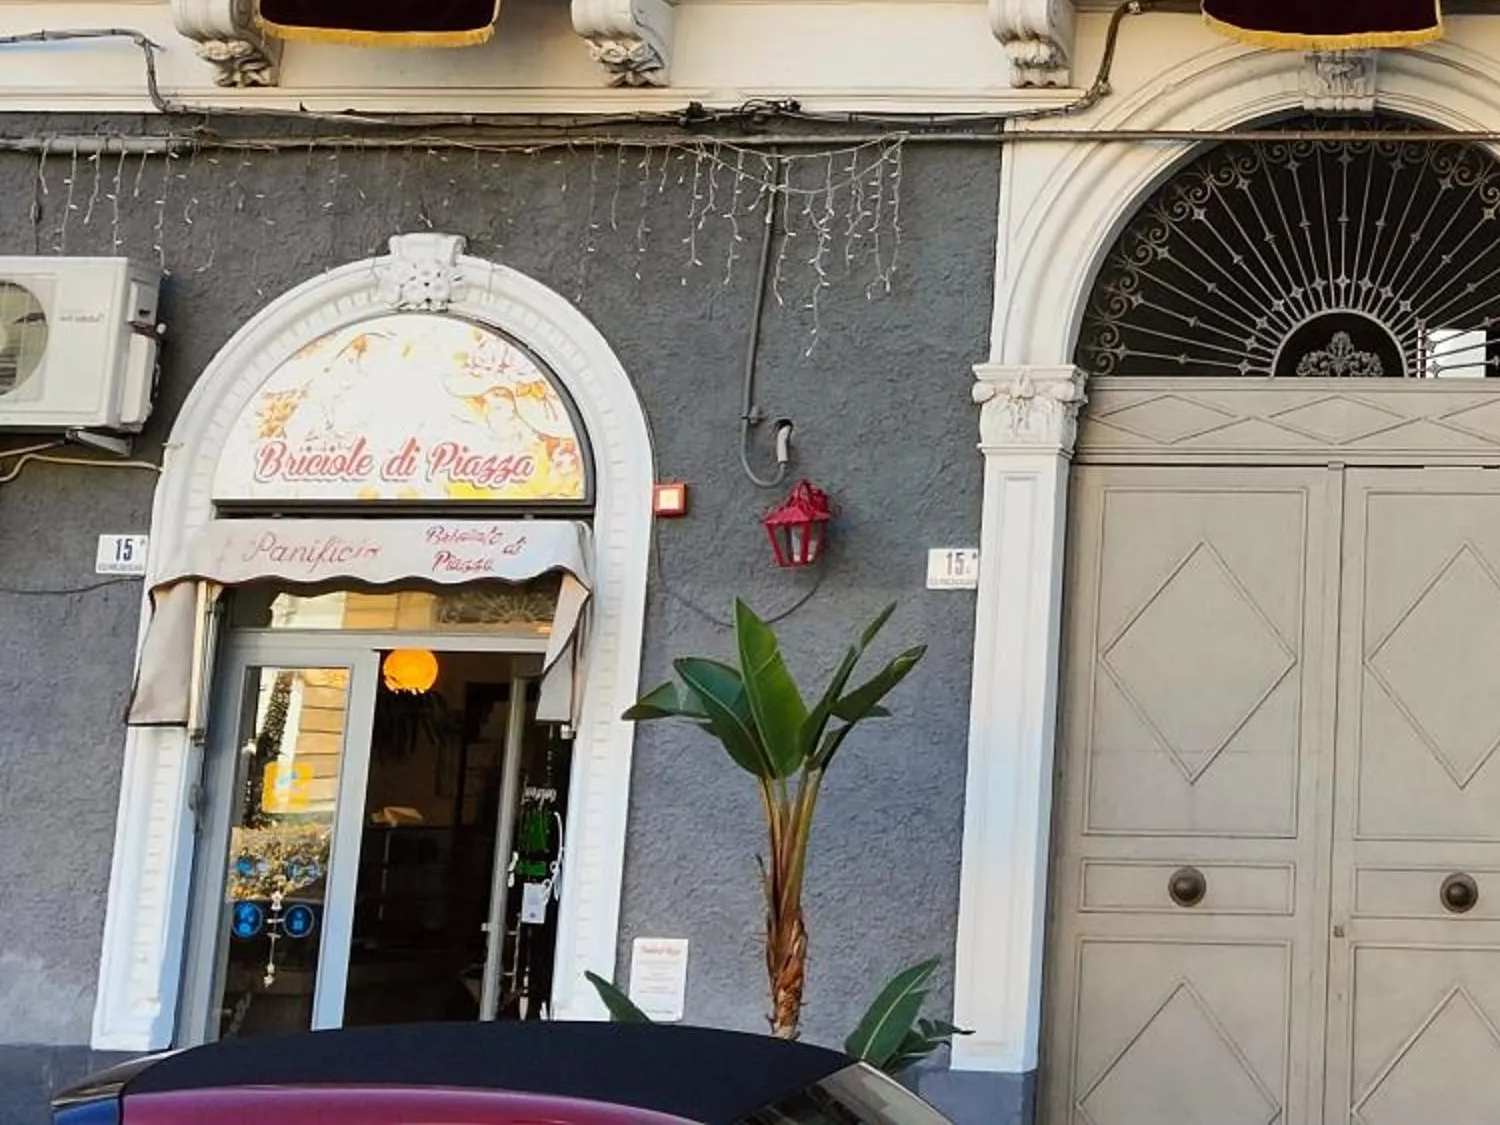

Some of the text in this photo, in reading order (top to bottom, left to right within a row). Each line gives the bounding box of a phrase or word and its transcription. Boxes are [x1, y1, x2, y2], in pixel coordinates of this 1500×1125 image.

[257, 435, 536, 485] Briciole di Piazza
